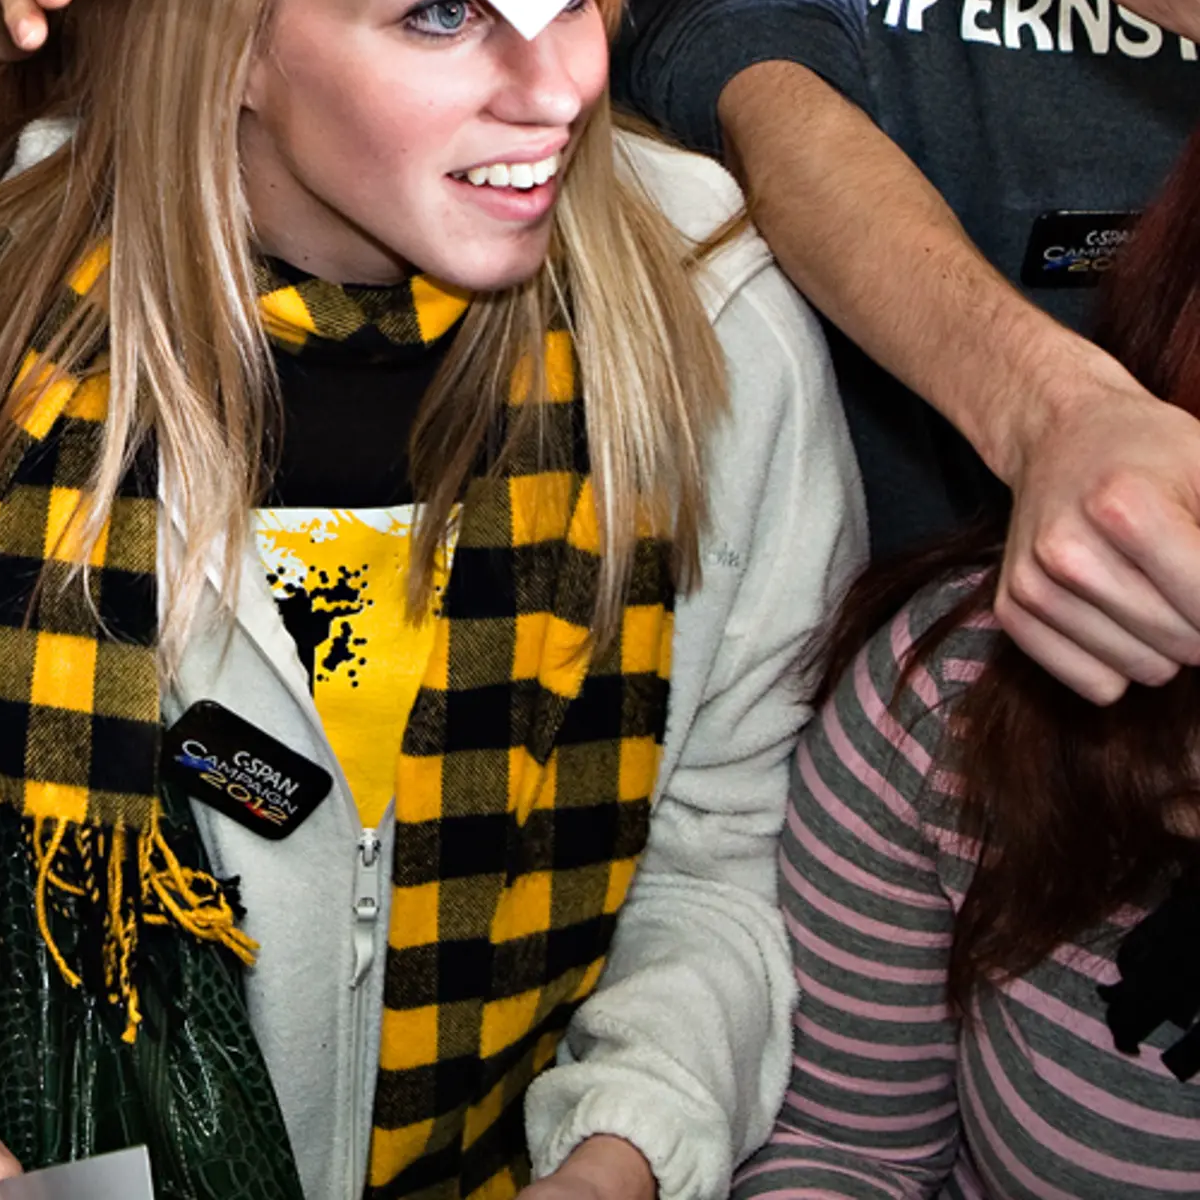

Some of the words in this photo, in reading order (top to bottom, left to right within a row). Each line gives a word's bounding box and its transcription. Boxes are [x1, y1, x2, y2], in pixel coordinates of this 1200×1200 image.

[181, 738, 299, 815] CAMPAIGN
[199, 766, 289, 827] 2012
[232, 750, 300, 797] C-SPAN
